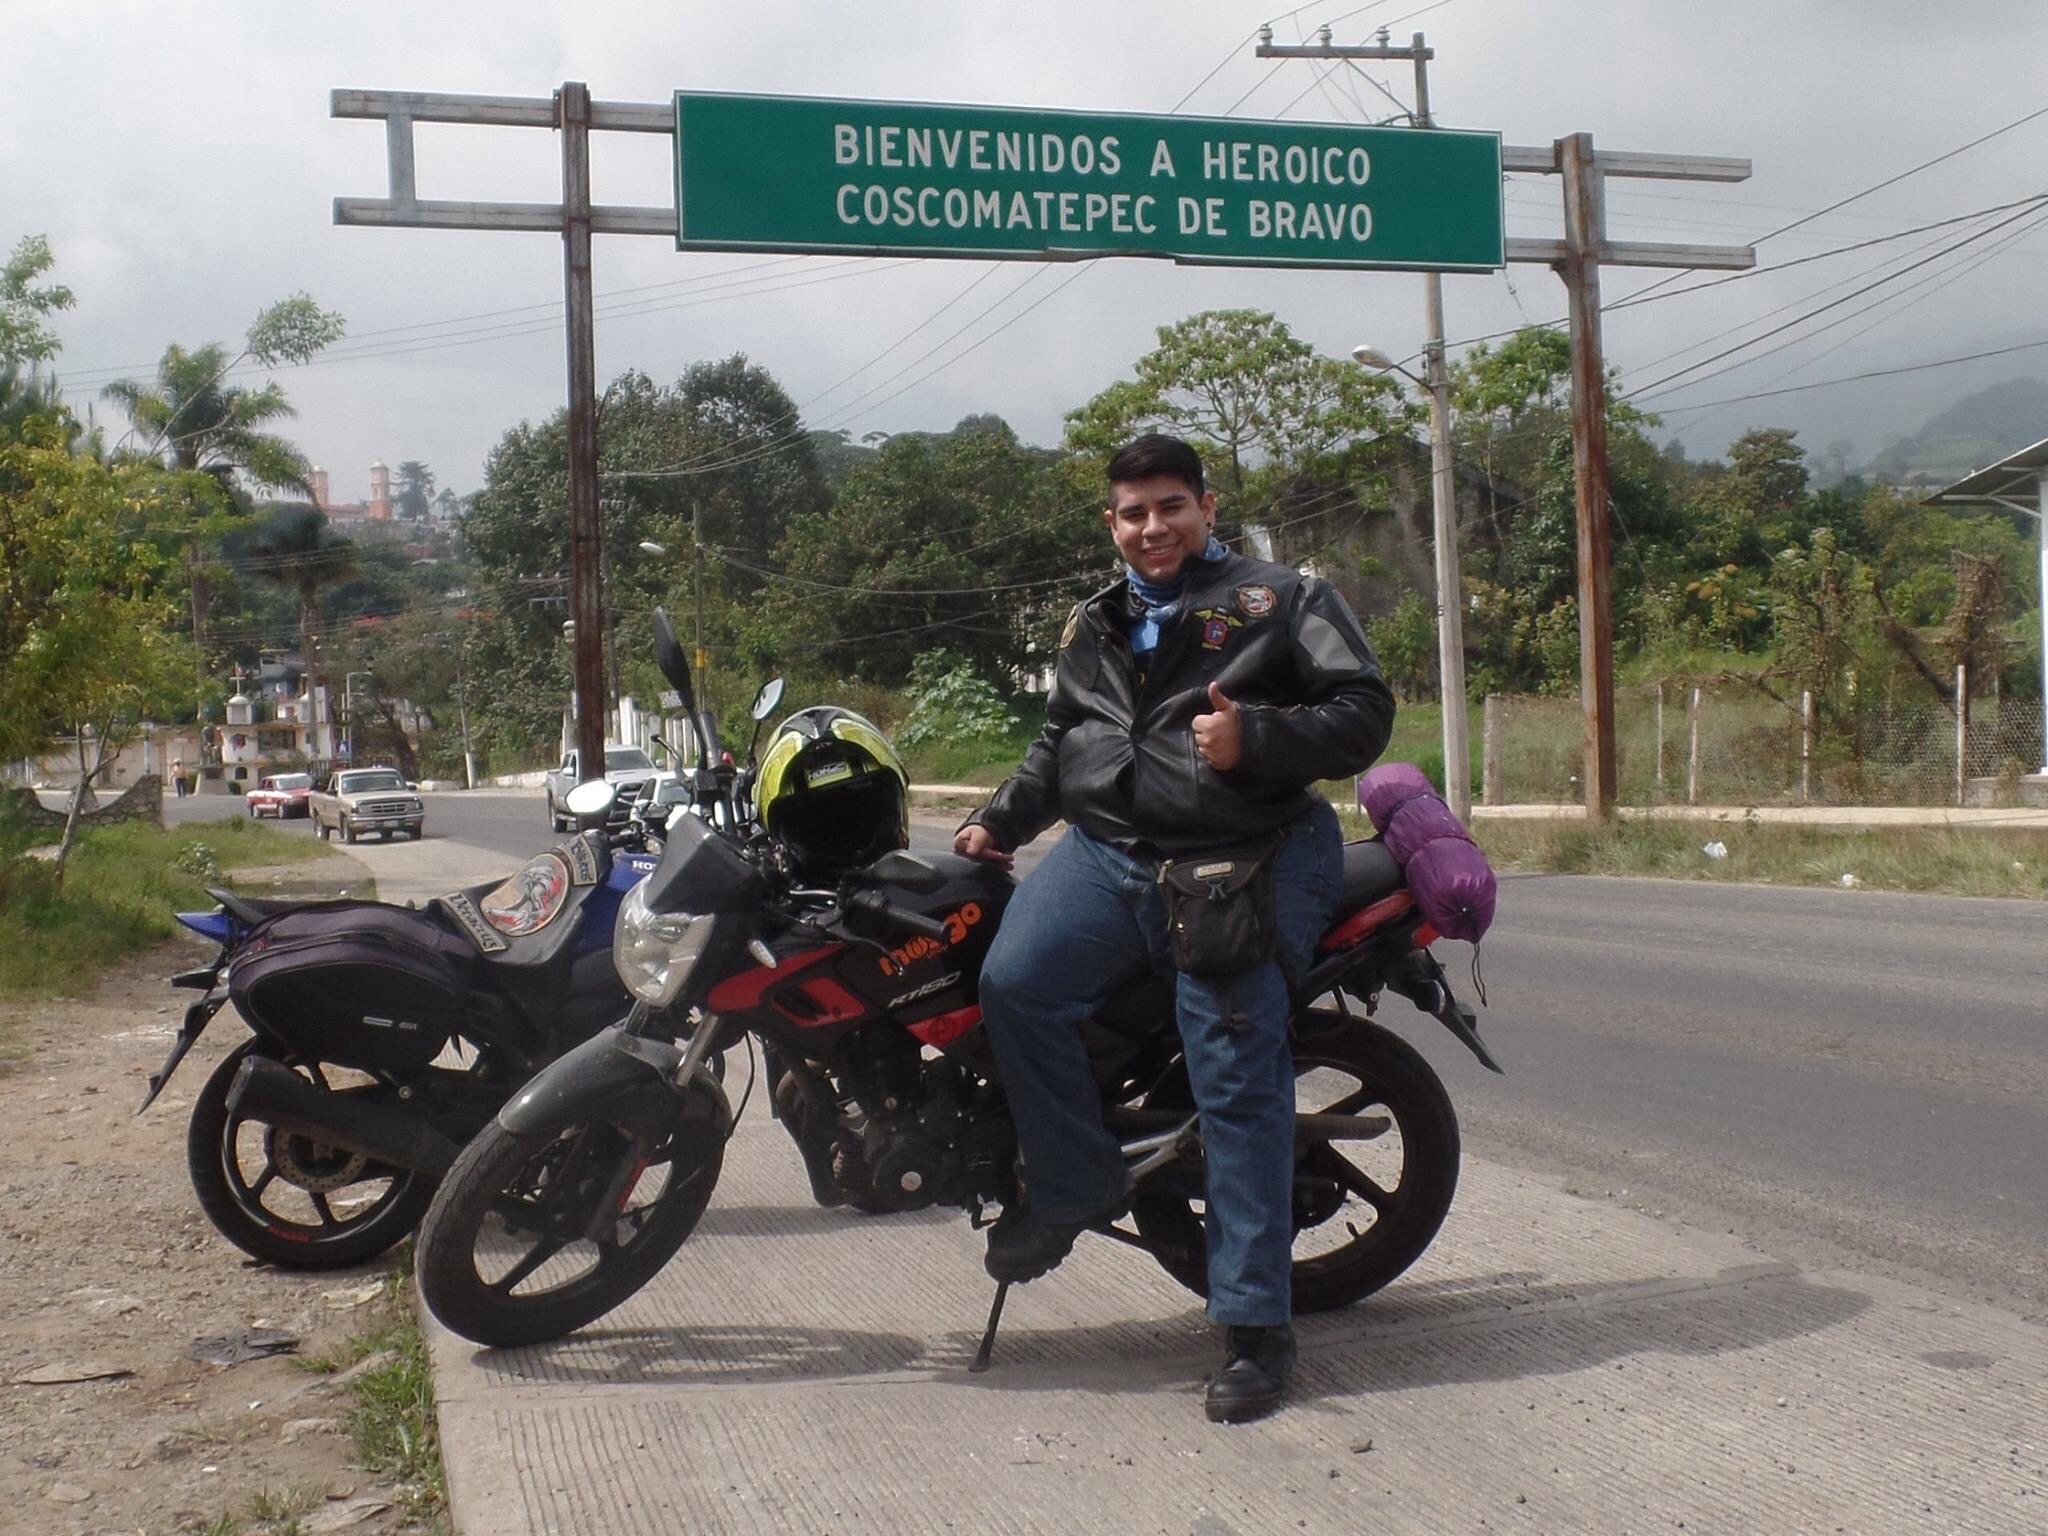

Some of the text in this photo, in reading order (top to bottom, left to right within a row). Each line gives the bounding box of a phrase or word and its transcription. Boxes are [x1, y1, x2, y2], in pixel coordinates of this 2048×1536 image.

[834, 124, 1371, 186] BIENVENIDOS A HEROICO
[836, 184, 1373, 242] COSCOMATEPEC DE BRAVO
